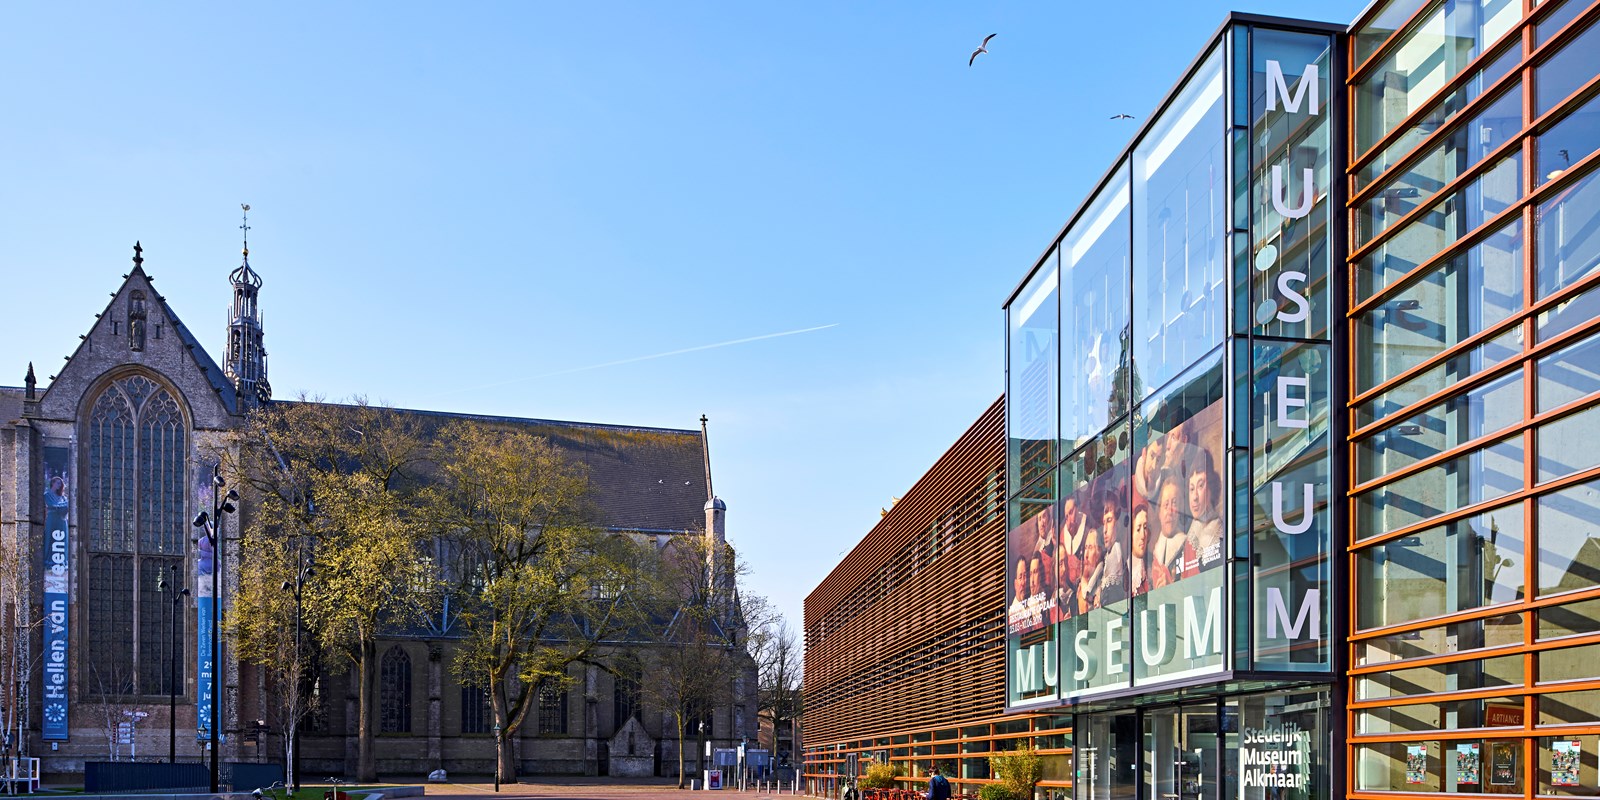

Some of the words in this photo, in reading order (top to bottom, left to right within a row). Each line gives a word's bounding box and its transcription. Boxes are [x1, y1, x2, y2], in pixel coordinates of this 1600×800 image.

[1265, 59, 1319, 640] MUSEUM
[46, 529, 65, 594] Meene
[51, 600, 65, 634] van
[1016, 586, 1223, 693] MUSEUM
[45, 640, 65, 698] Hellen
[1244, 721, 1302, 747] Stedelijk
[1491, 713, 1520, 724] ARTIANCE
[1244, 748, 1302, 765] Museum
[1244, 768, 1302, 788] Alkmaar
